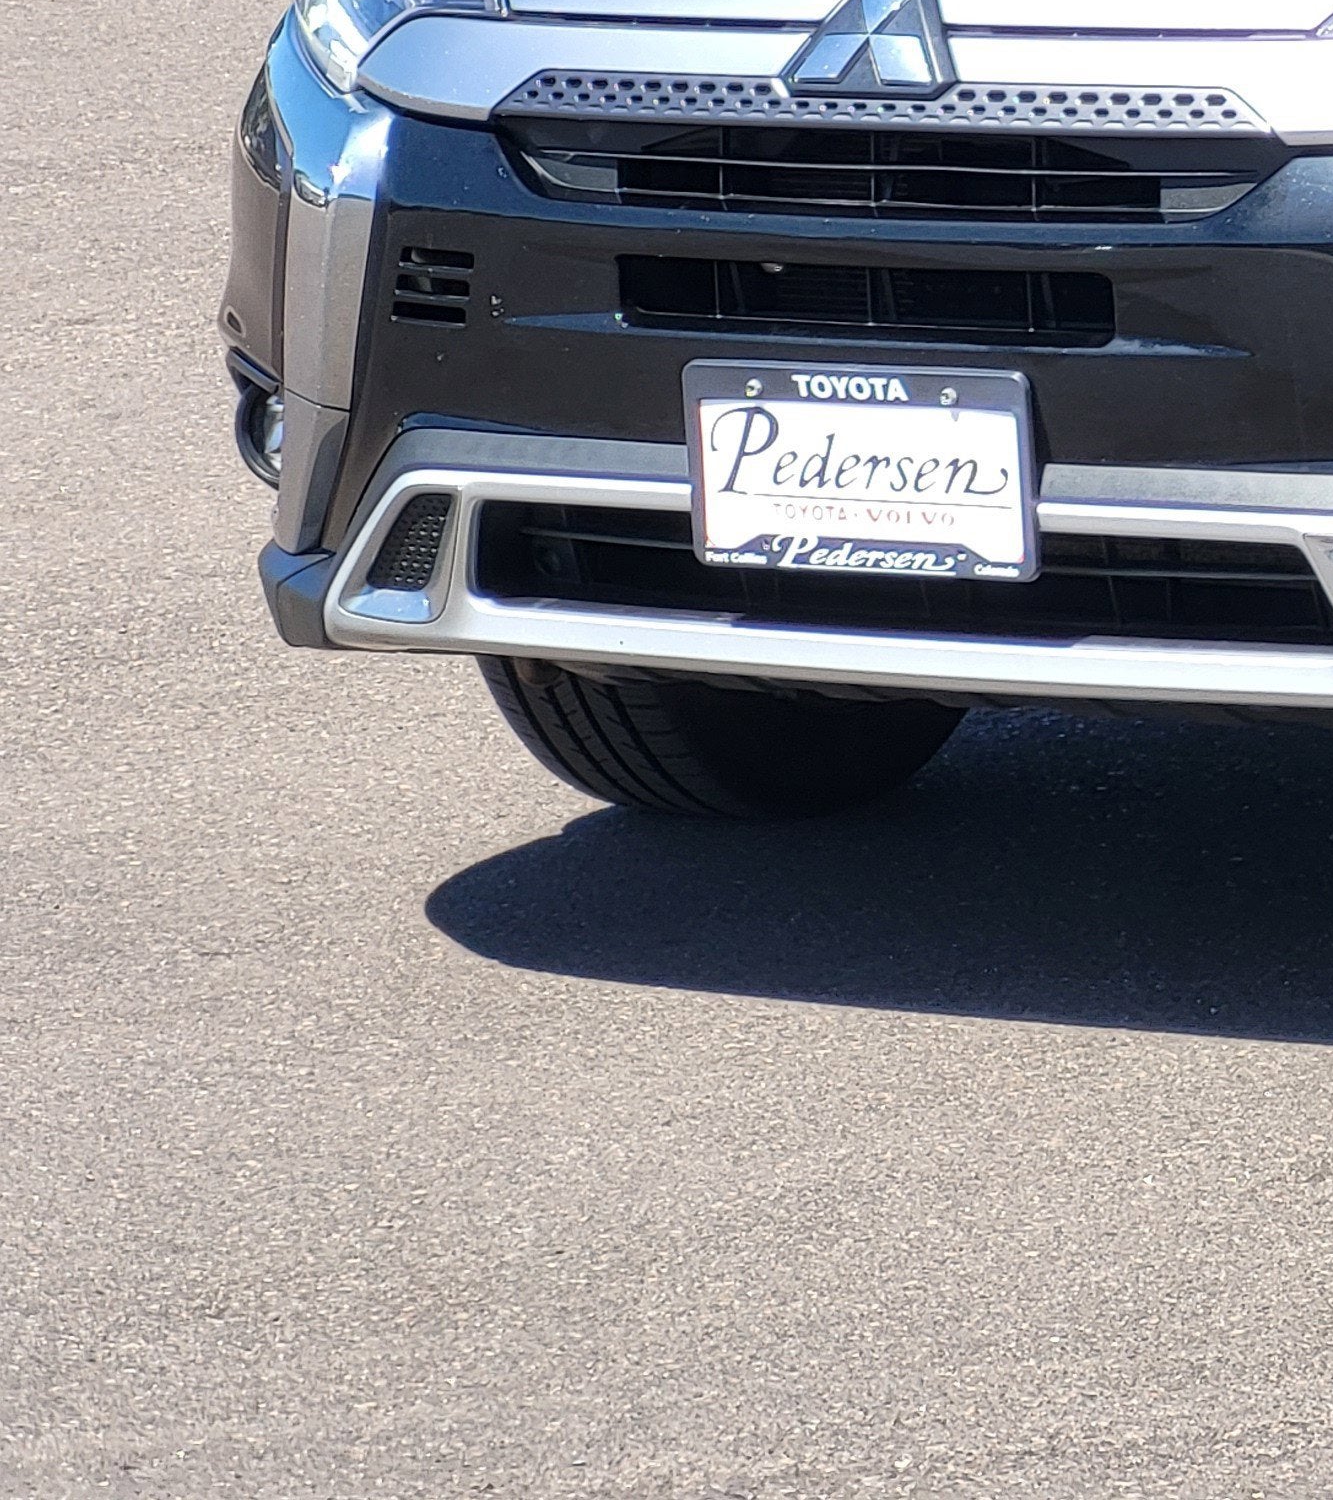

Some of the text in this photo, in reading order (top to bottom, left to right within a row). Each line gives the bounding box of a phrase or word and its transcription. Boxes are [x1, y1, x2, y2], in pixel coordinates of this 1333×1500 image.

[791, 374, 909, 401] TOYOTA
[711, 406, 1009, 495] Pedersen
[773, 503, 847, 521] TOYOTA
[771, 535, 955, 572] Pedersen
